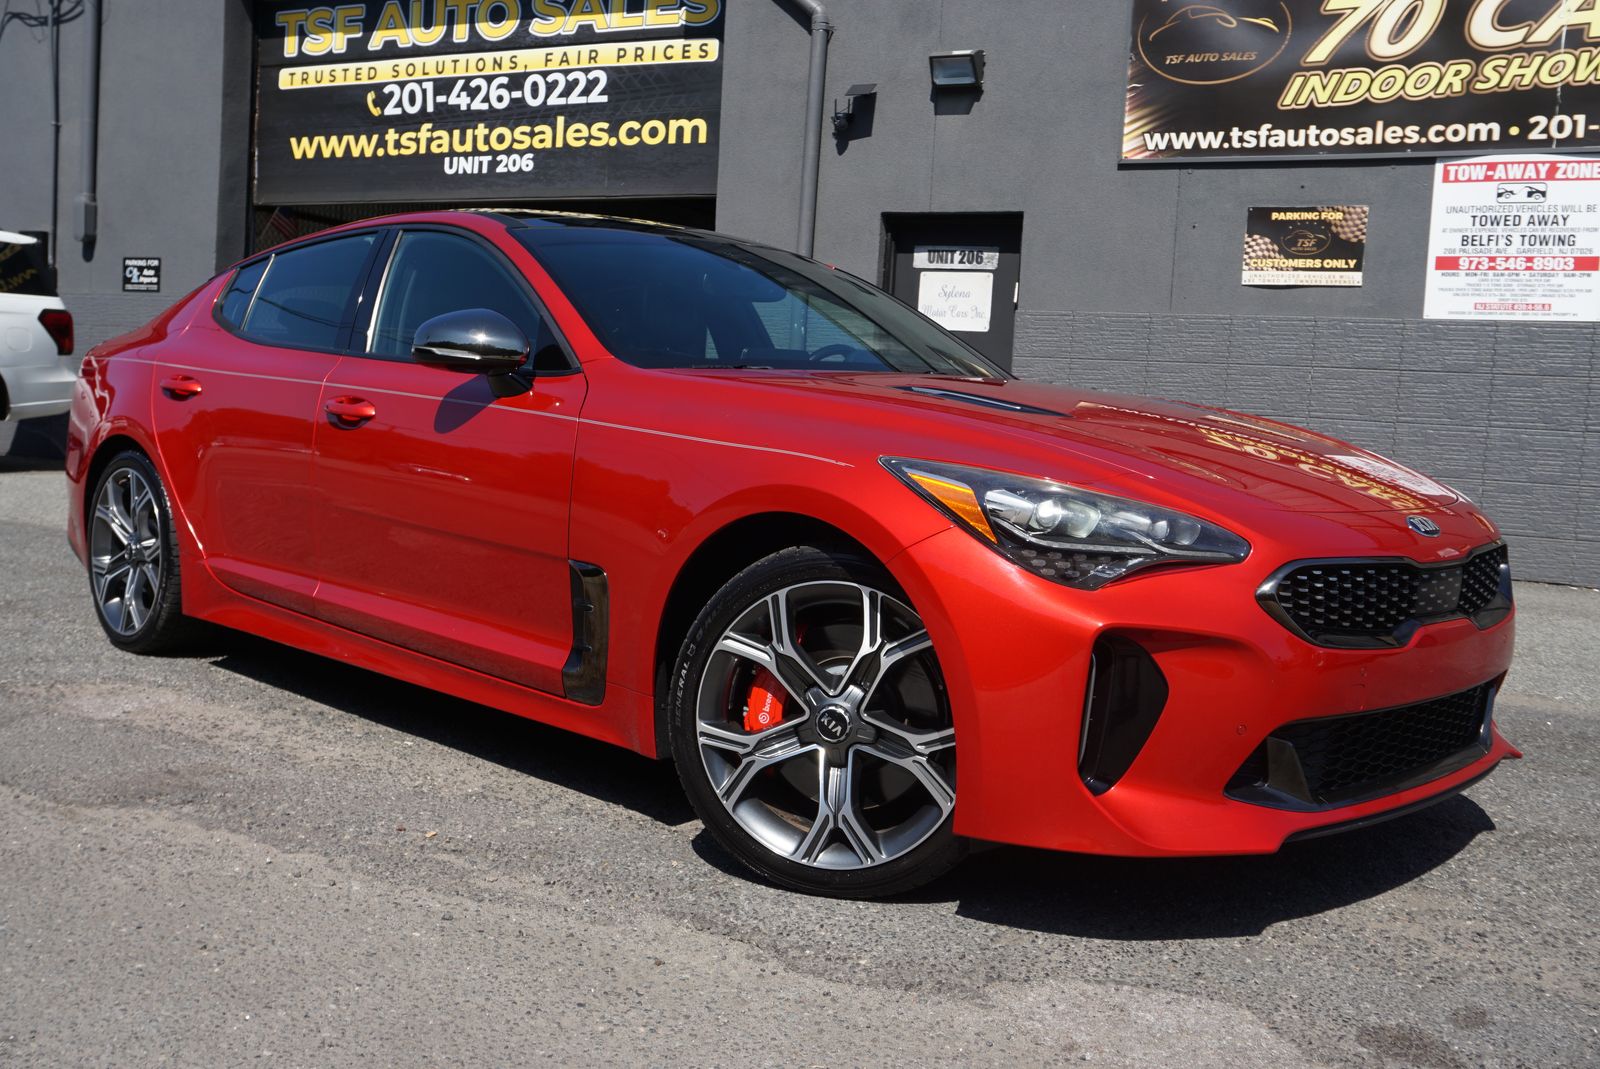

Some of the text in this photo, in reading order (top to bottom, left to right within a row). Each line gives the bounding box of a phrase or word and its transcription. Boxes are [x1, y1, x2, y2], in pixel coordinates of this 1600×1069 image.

[276, 0, 721, 57] TSF AUTO SALES
[1301, 0, 1447, 66] 70
[289, 43, 710, 86] TRUSTED SOLUTIONS, FAIR PRICES
[1165, 51, 1257, 64] TSF AUTO SALES
[382, 70, 609, 116] 201-426-0222
[1278, 59, 1475, 110] INDOOR
[290, 115, 708, 160] www.tsfautosales.com
[1143, 120, 1501, 151] www.tsfautosales.com
[444, 153, 534, 175] UNIT 206
[1446, 162, 1600, 181] TOW-AWAY ZONE
[1271, 212, 1344, 221] PARKING FOR
[1446, 204, 1597, 214] UNAUTHORIZED VEHICLES WILL BE
[1471, 214, 1570, 227] TOWED AWAY
[1296, 239, 1317, 247] TSF
[1461, 234, 1576, 247] BELFI'S TOWING
[928, 250, 984, 265] UNIT 206
[1250, 258, 1357, 268] CUSTOMERS ONLY
[1458, 257, 1575, 270] 973-546-8903
[820, 712, 843, 737] KIA
